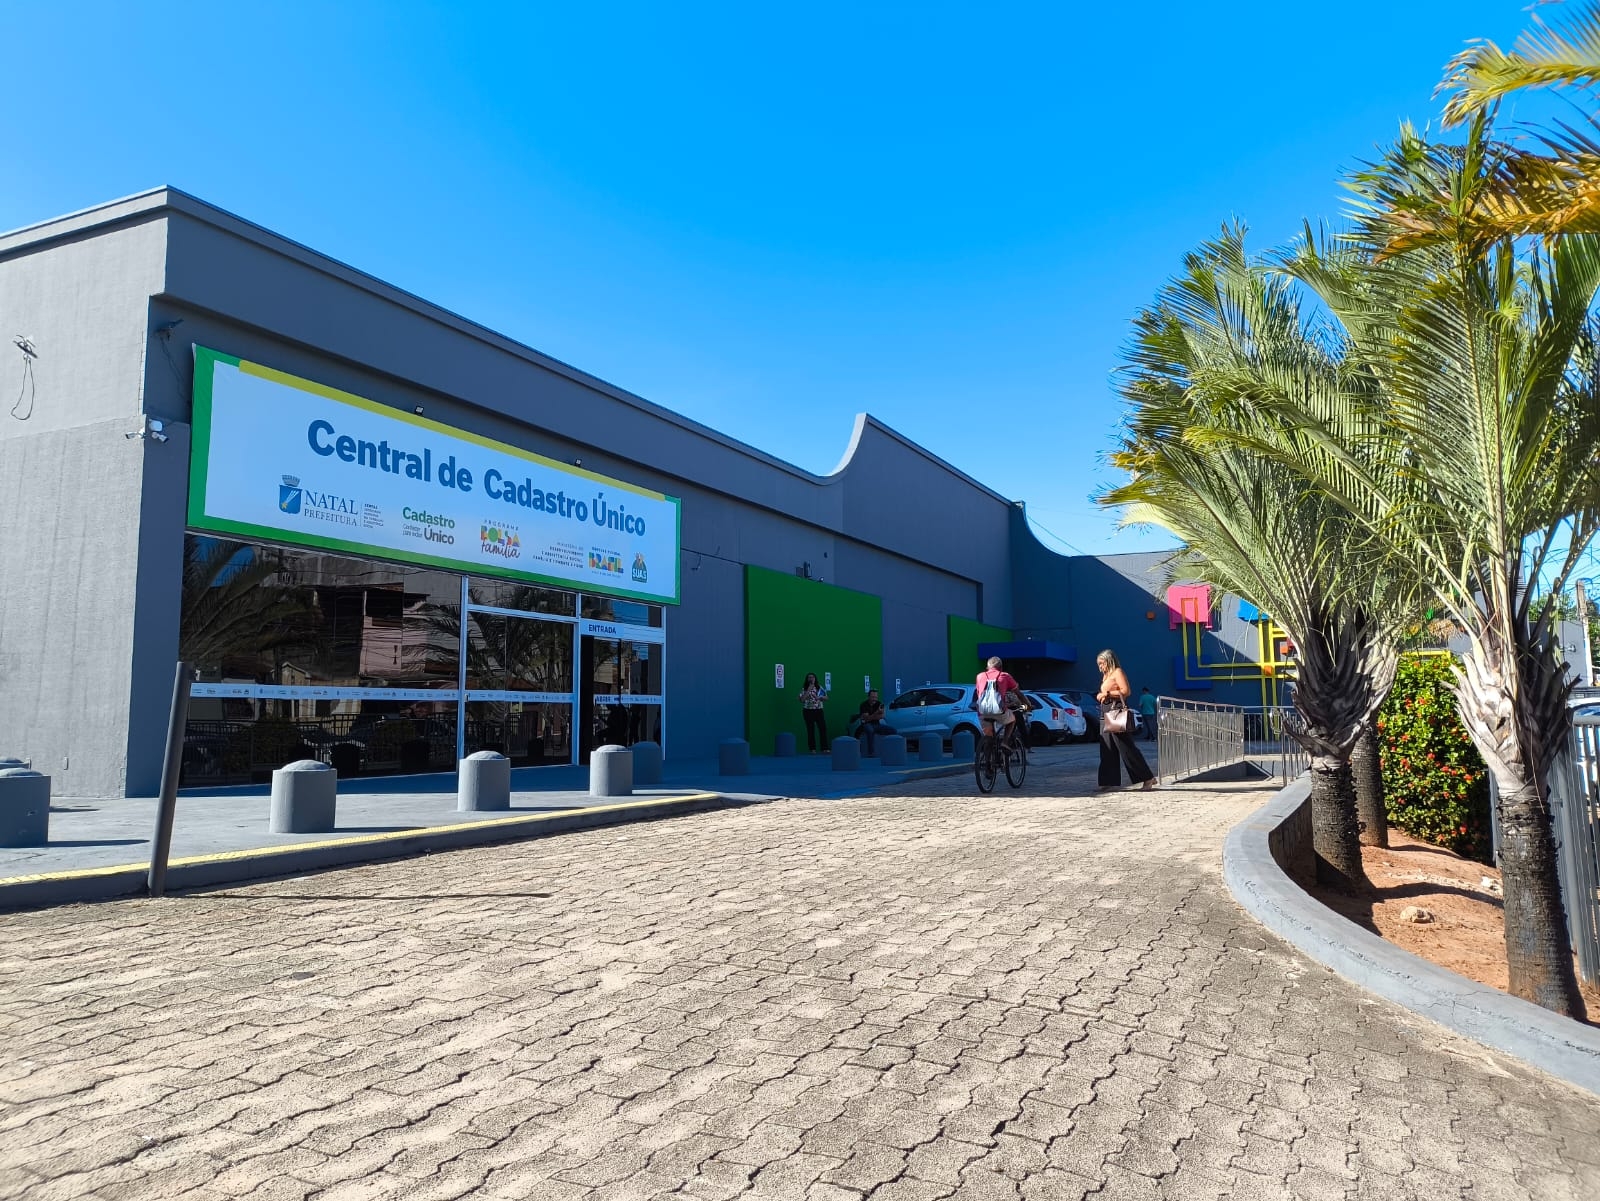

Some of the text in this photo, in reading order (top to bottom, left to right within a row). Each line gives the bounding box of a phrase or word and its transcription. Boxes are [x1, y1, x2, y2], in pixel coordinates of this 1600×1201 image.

[307, 419, 646, 537] Central de Cadastro Único
[304, 489, 358, 516] NATAL
[303, 508, 358, 527] PREFEITURA
[402, 506, 455, 529] Cadastro
[483, 519, 519, 531] PROGRAMA
[424, 525, 455, 545] Único
[480, 525, 520, 548] BOLSA
[588, 551, 624, 574] BRASIL
[632, 567, 647, 579] SUAS
[588, 623, 617, 634] ENTRADA
